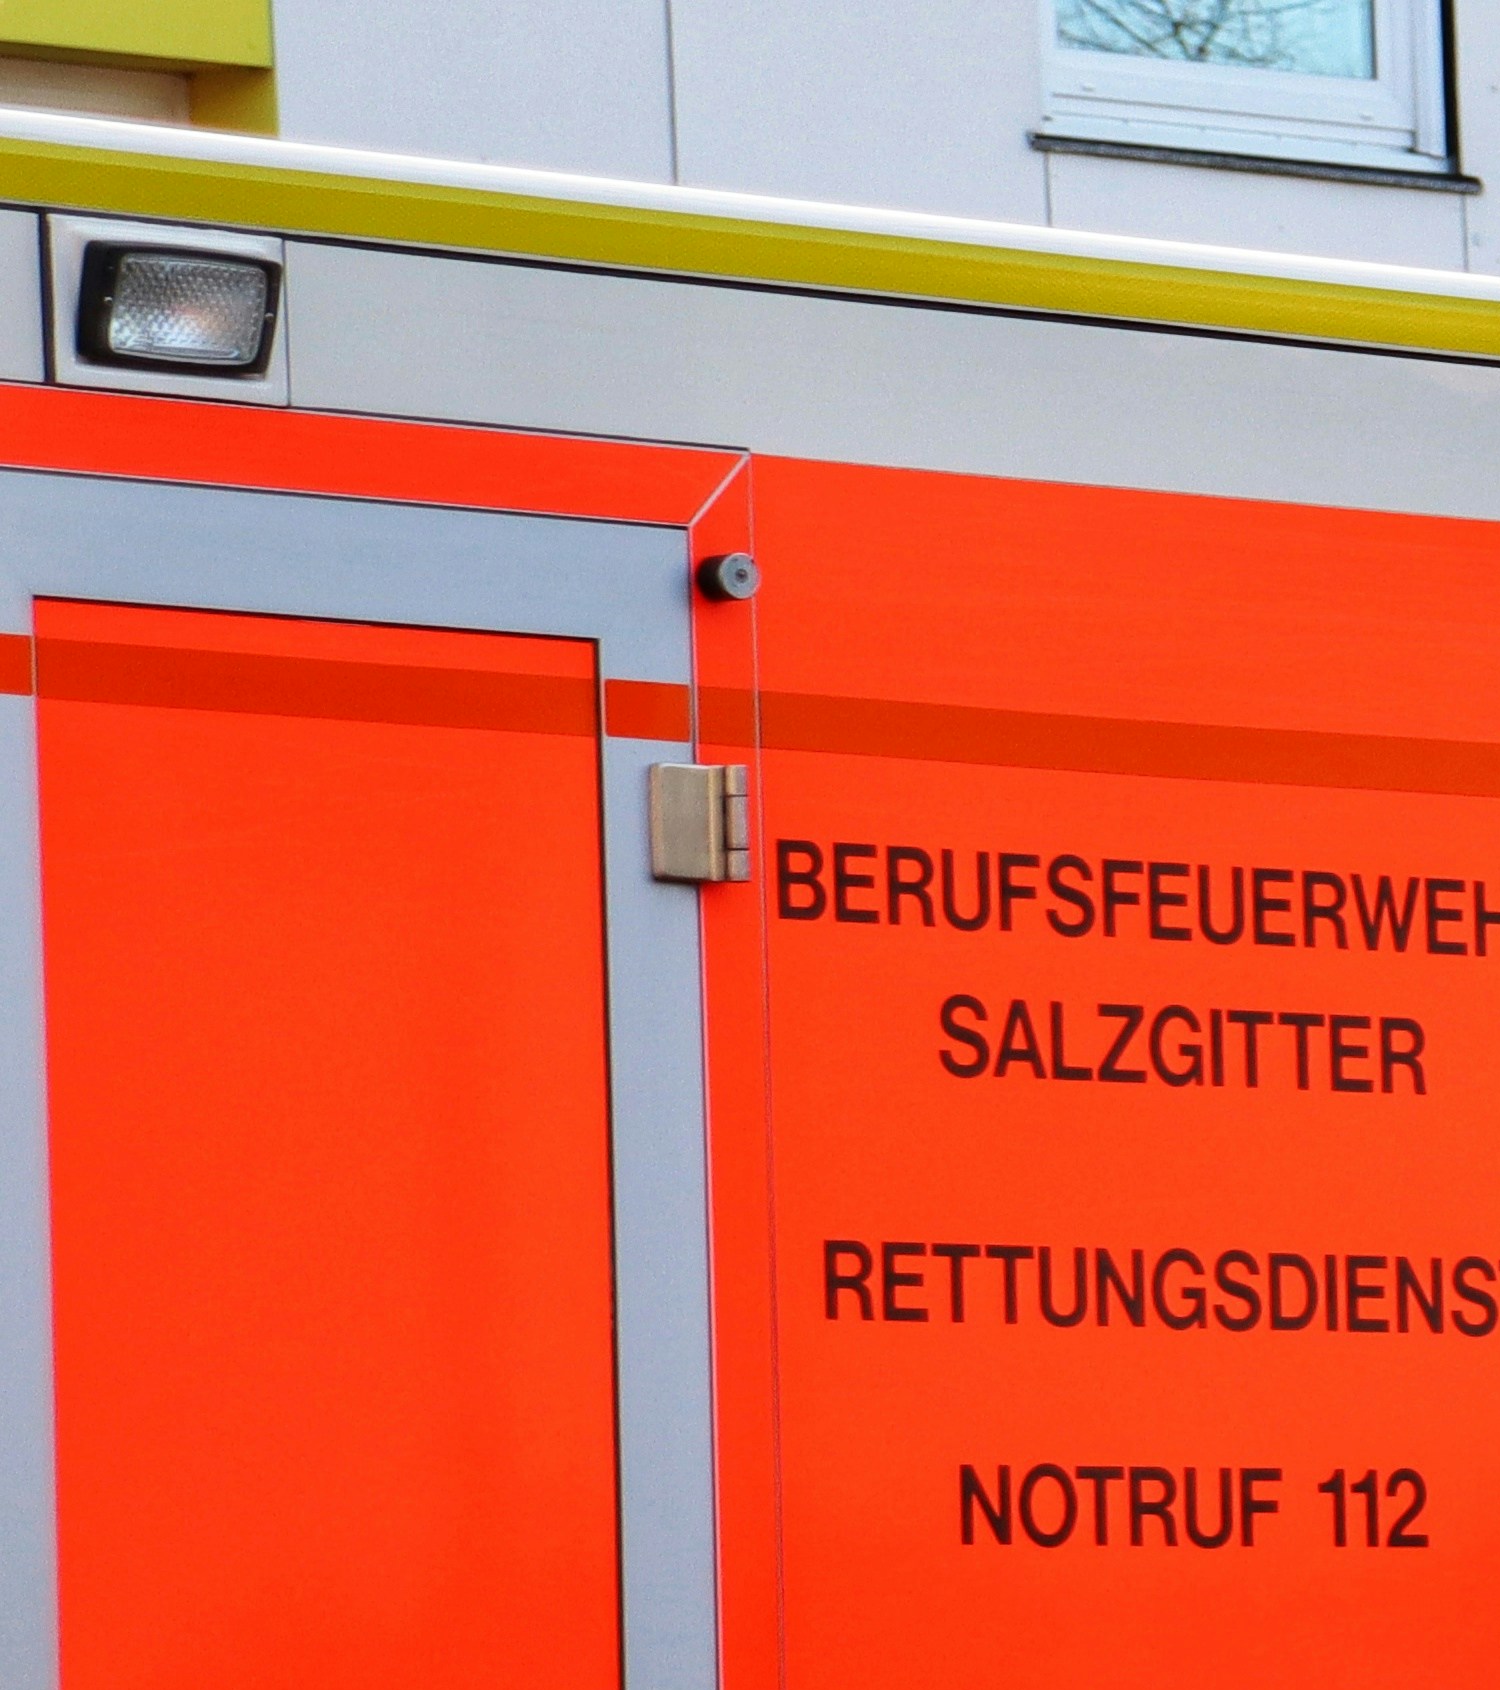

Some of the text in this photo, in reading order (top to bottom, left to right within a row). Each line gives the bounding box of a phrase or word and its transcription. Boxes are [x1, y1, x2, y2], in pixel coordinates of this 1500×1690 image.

[938, 993, 1428, 1096] SALZGITTER
[958, 1462, 1430, 1550] NOTRUF 112
